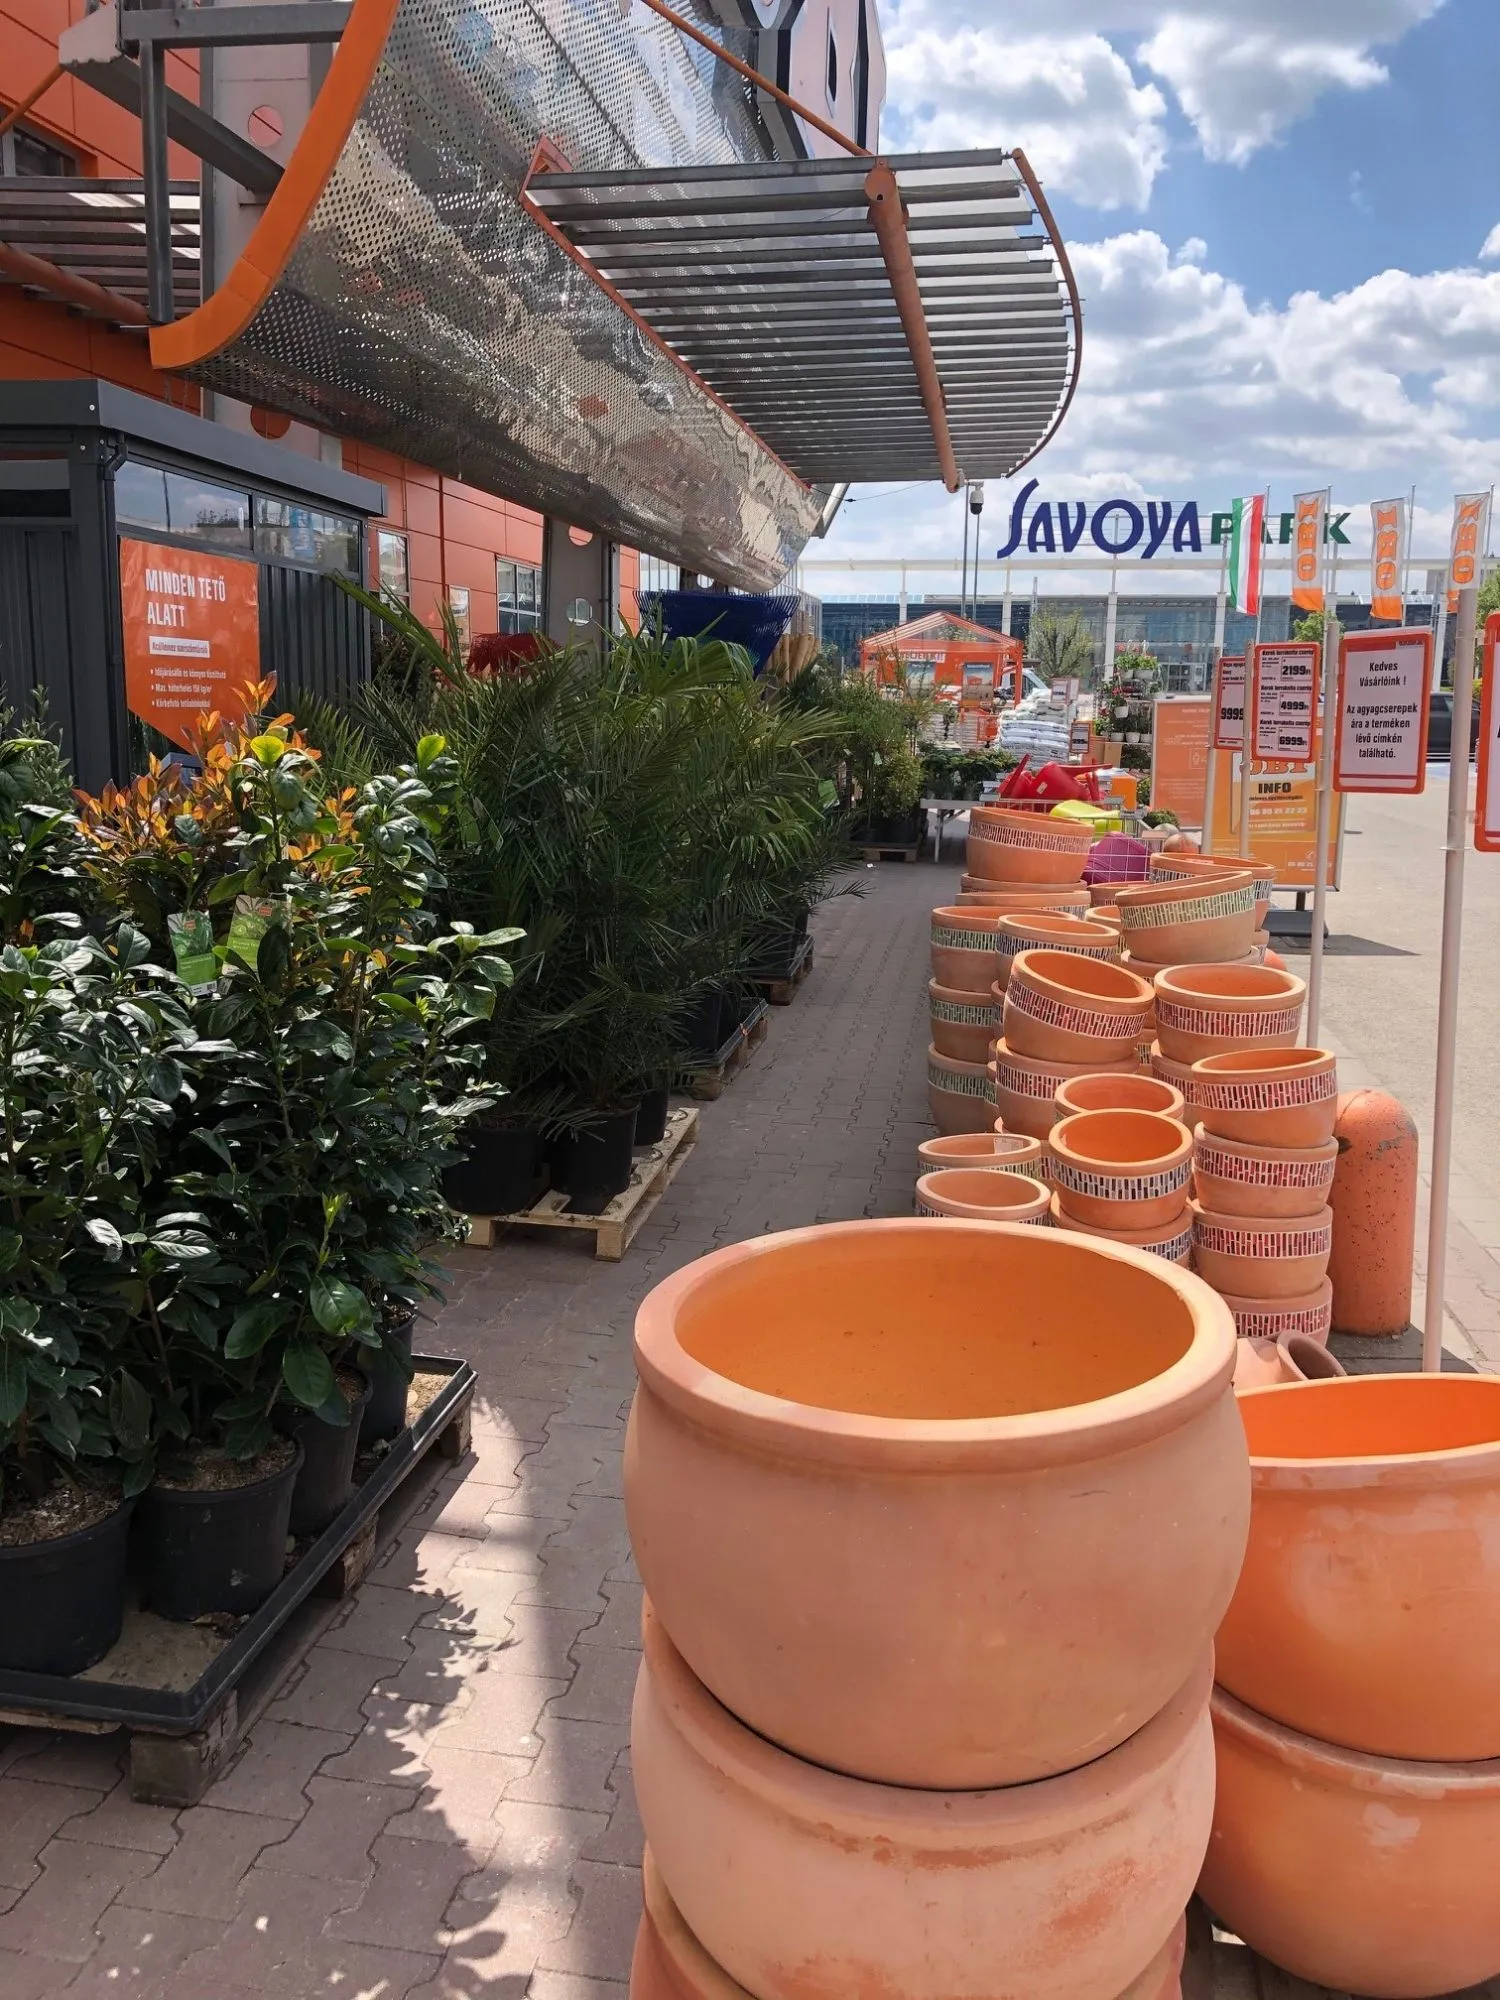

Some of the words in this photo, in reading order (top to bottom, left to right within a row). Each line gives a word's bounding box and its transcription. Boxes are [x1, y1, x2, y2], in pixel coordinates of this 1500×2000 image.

[997, 478, 1202, 559] SAVOYA
[1210, 512, 1352, 545] PRK
[1297, 498, 1319, 581] OBI
[1452, 497, 1481, 584] OBI
[1375, 505, 1399, 590] OBI
[145, 569, 196, 597] MINDEN
[198, 575, 226, 602] TETŐ
[147, 601, 185, 627] ALATT
[1369, 662, 1398, 671] Kedves
[1359, 676, 1400, 687] Vásárlóink
[1347, 705, 1355, 714] Az
[1357, 703, 1418, 716] agyagcserepek
[1351, 719, 1363, 728] ára
[1371, 718, 1410, 728] terméken
[1356, 733, 1371, 743] lévő
[1359, 748, 1396, 758] található.
[1258, 782, 1292, 794] INFO
